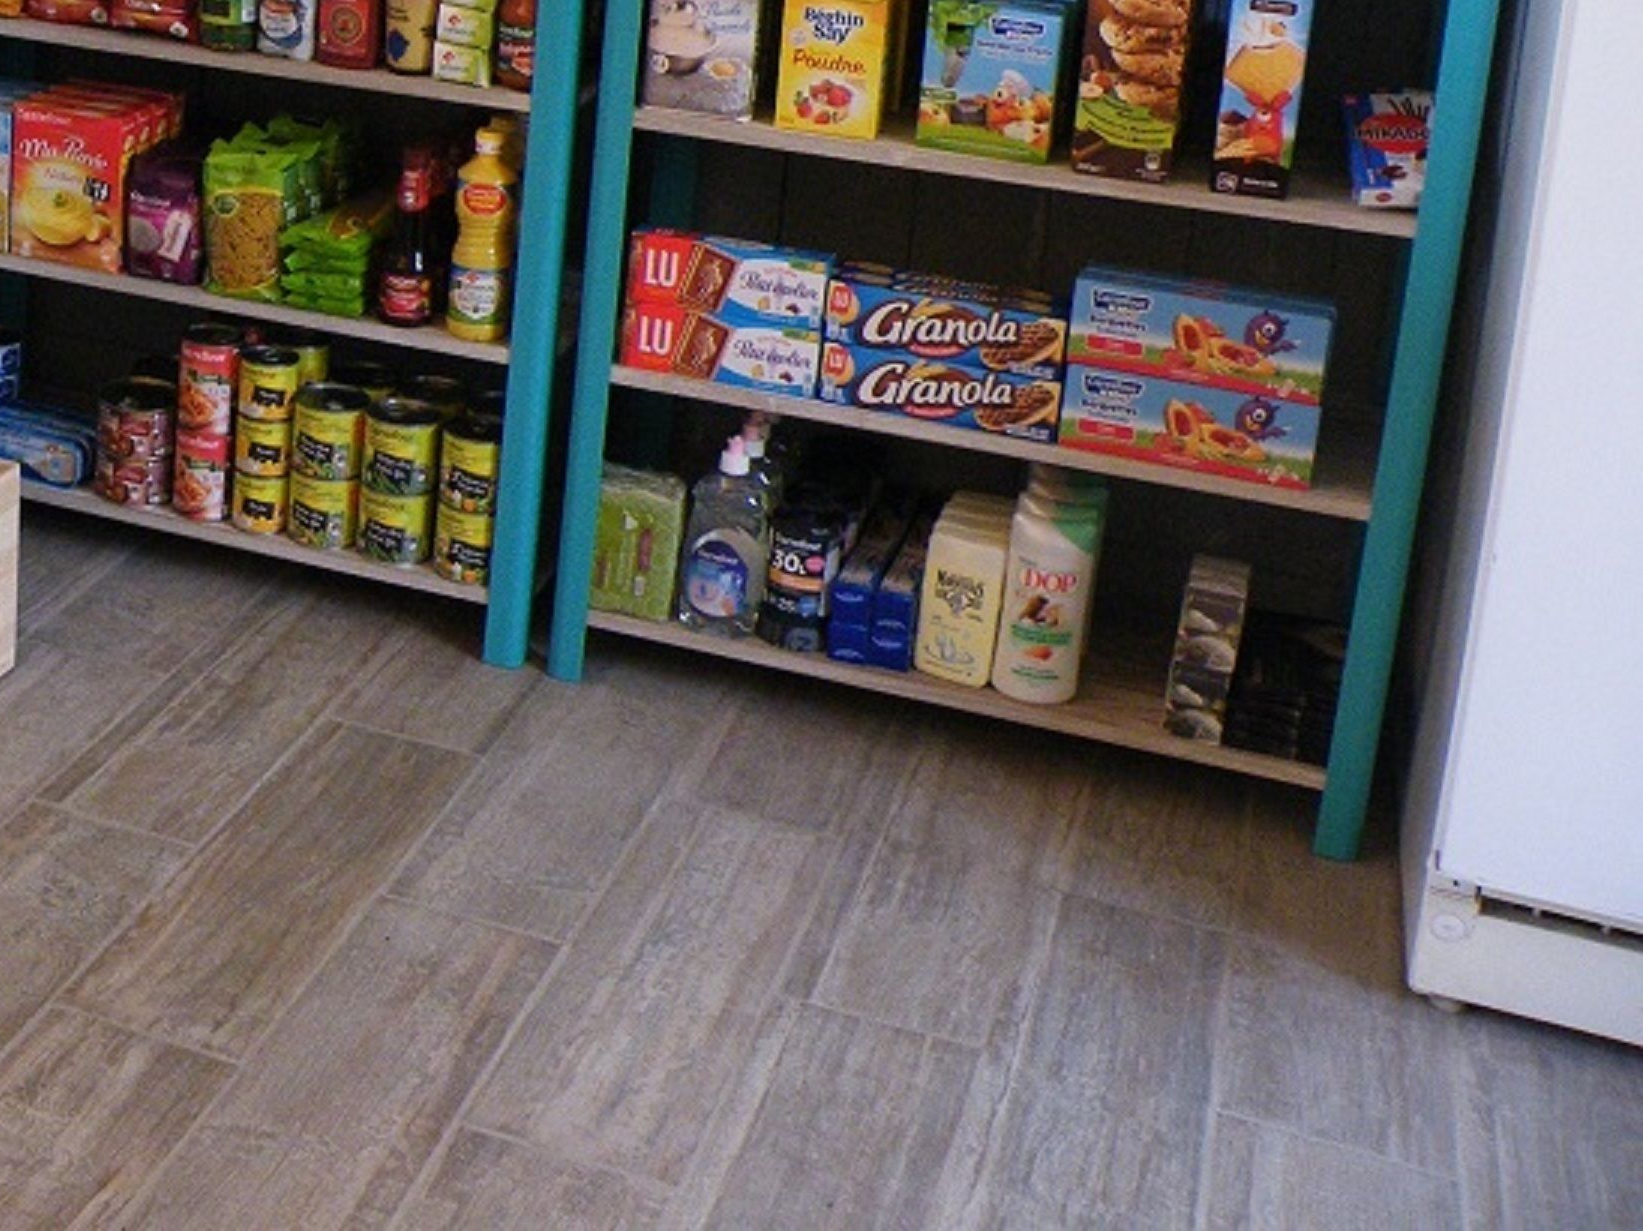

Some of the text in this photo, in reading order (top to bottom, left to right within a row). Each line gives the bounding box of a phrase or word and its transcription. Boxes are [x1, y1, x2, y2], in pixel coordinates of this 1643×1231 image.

[804, 6, 865, 28] Béghin
[813, 24, 850, 46] Say
[793, 49, 867, 75] Poudre
[645, 248, 680, 287] LU
[637, 315, 674, 355] LU
[862, 302, 1019, 347] Granola
[858, 363, 1013, 410] Granola
[1022, 568, 1077, 592] DOP
